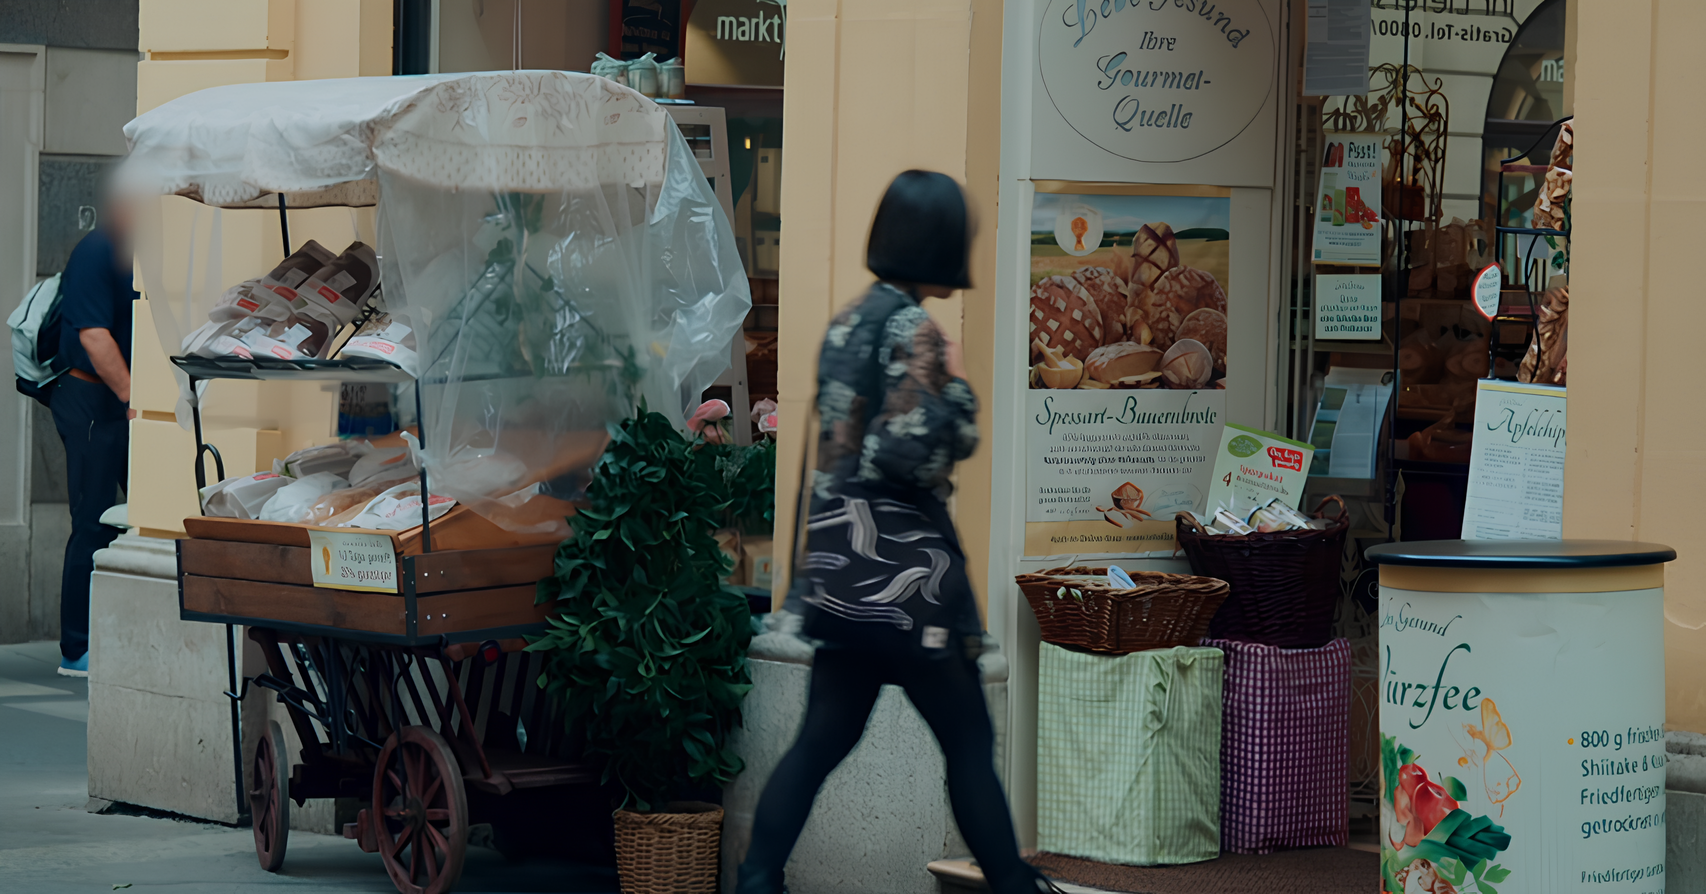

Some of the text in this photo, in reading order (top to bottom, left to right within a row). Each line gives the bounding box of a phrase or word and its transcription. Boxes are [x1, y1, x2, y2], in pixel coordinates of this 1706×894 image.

[716, 10, 782, 43] markt
[1581, 730, 1609, 748] 800
[1614, 733, 1623, 751] g
